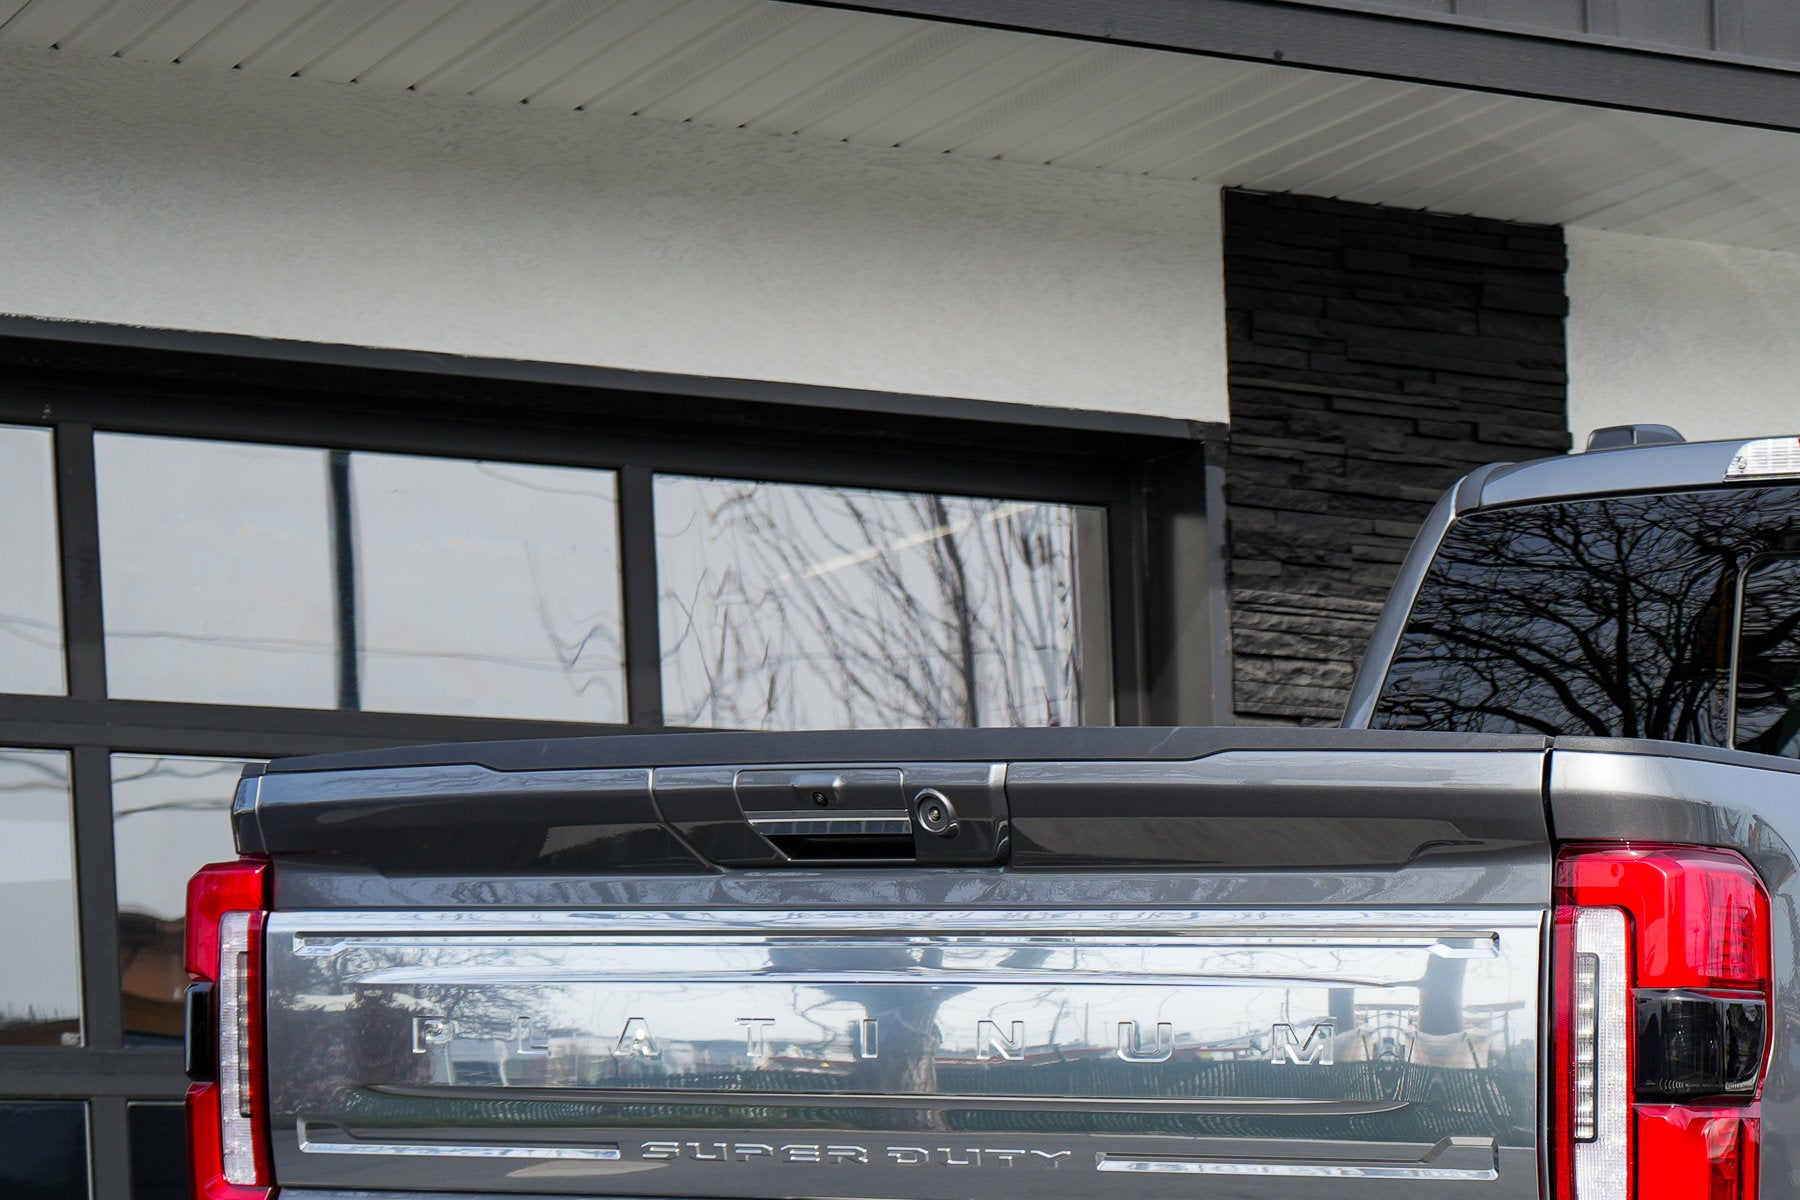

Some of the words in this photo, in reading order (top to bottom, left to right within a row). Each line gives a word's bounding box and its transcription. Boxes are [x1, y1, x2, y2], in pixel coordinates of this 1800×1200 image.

[411, 1013, 1336, 1066] PLATINUM
[640, 1140, 869, 1166] SUPER
[885, 1145, 1073, 1171] DUTY
